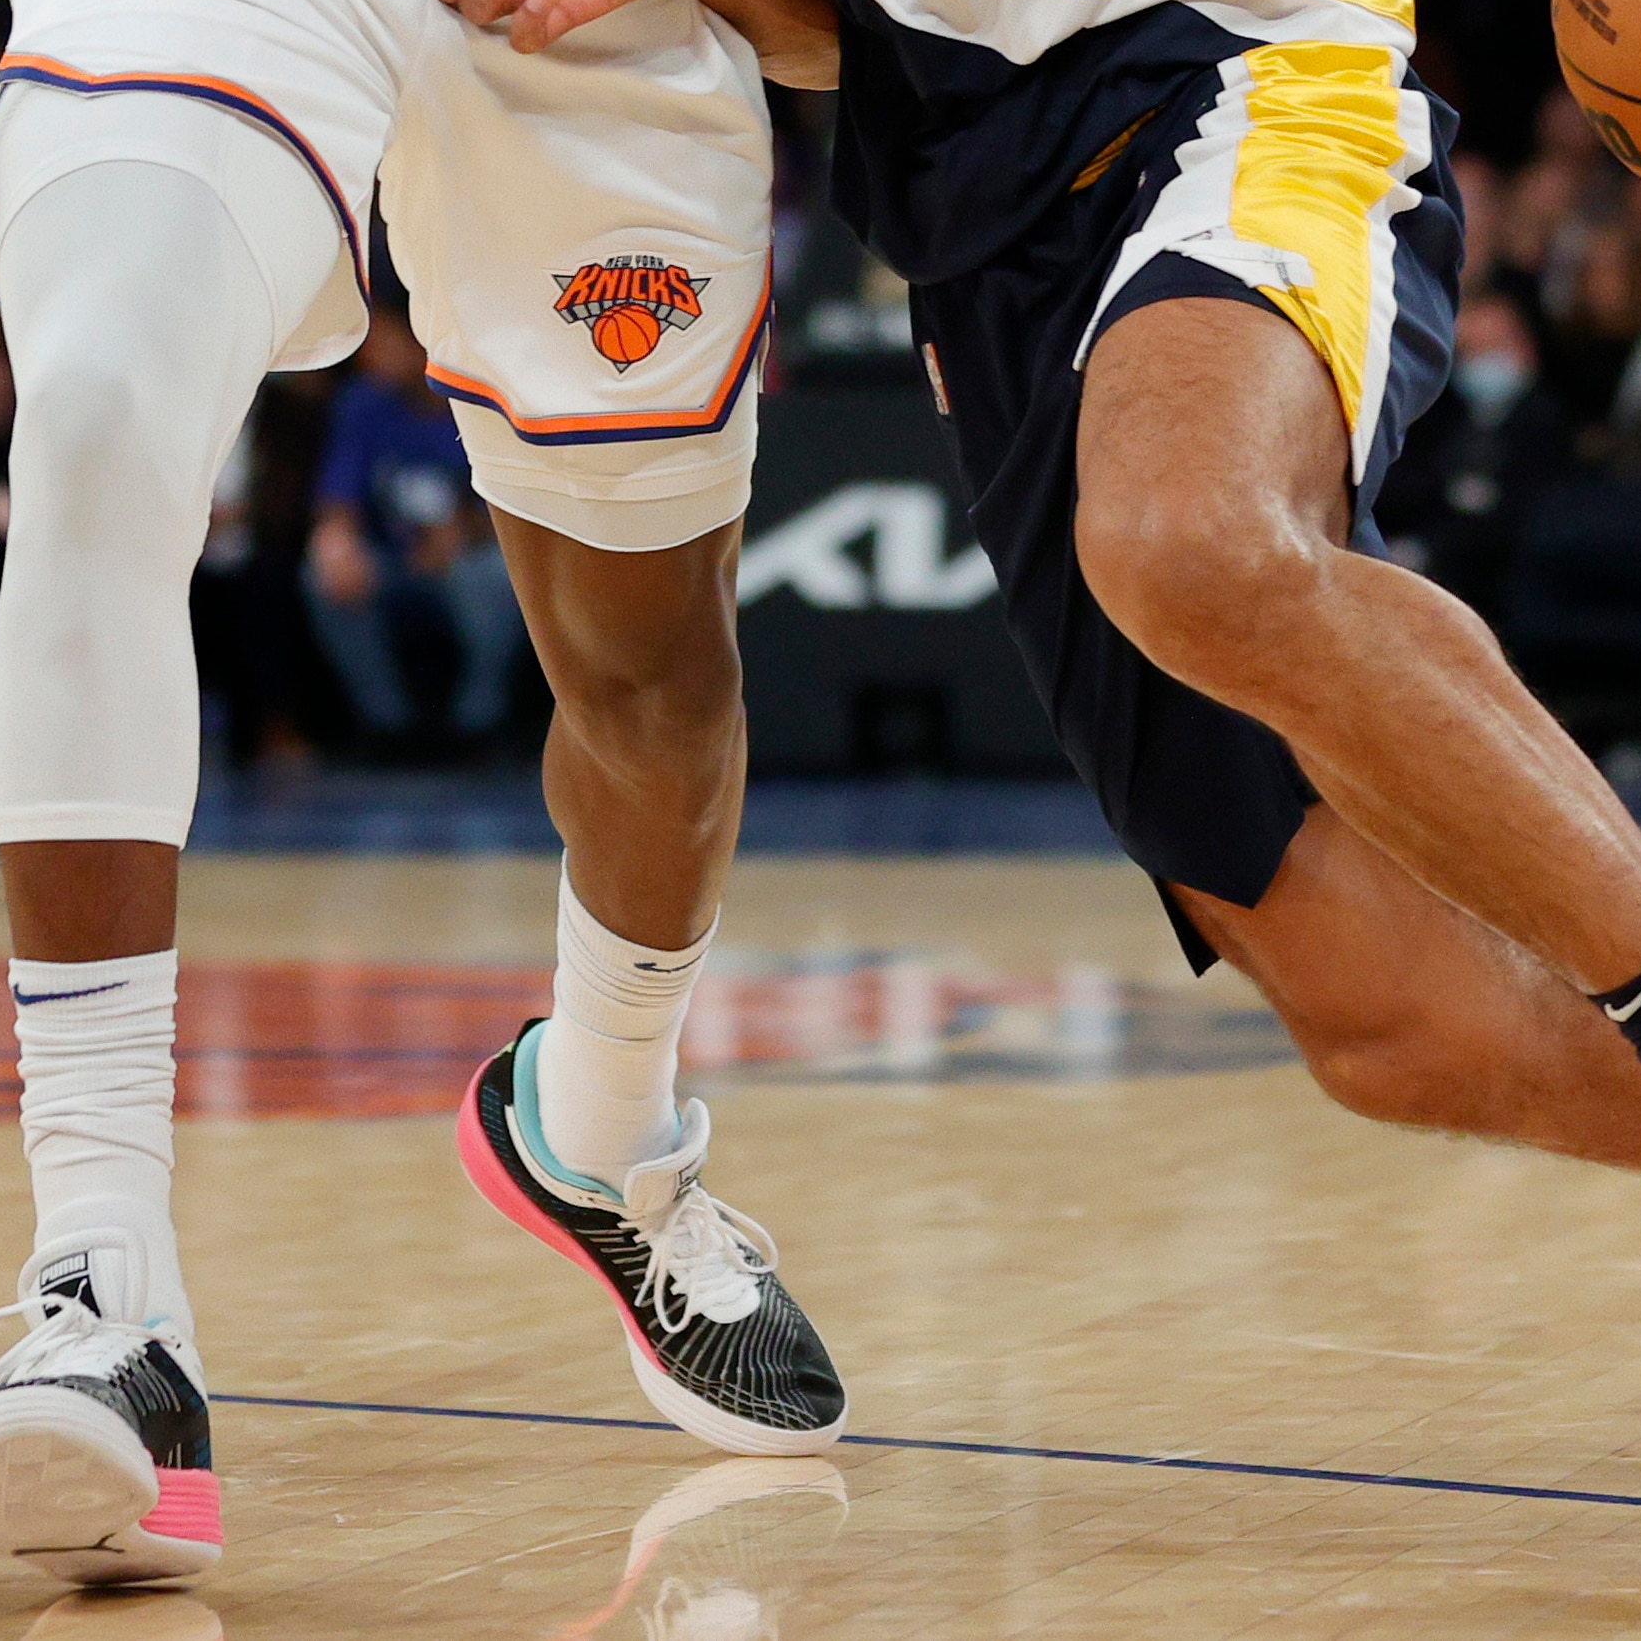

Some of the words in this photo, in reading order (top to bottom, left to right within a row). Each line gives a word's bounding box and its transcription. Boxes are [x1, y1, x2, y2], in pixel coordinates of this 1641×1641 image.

[605, 254, 633, 269] NEW
[635, 254, 666, 270] YORK
[553, 262, 703, 321] KNICKS
